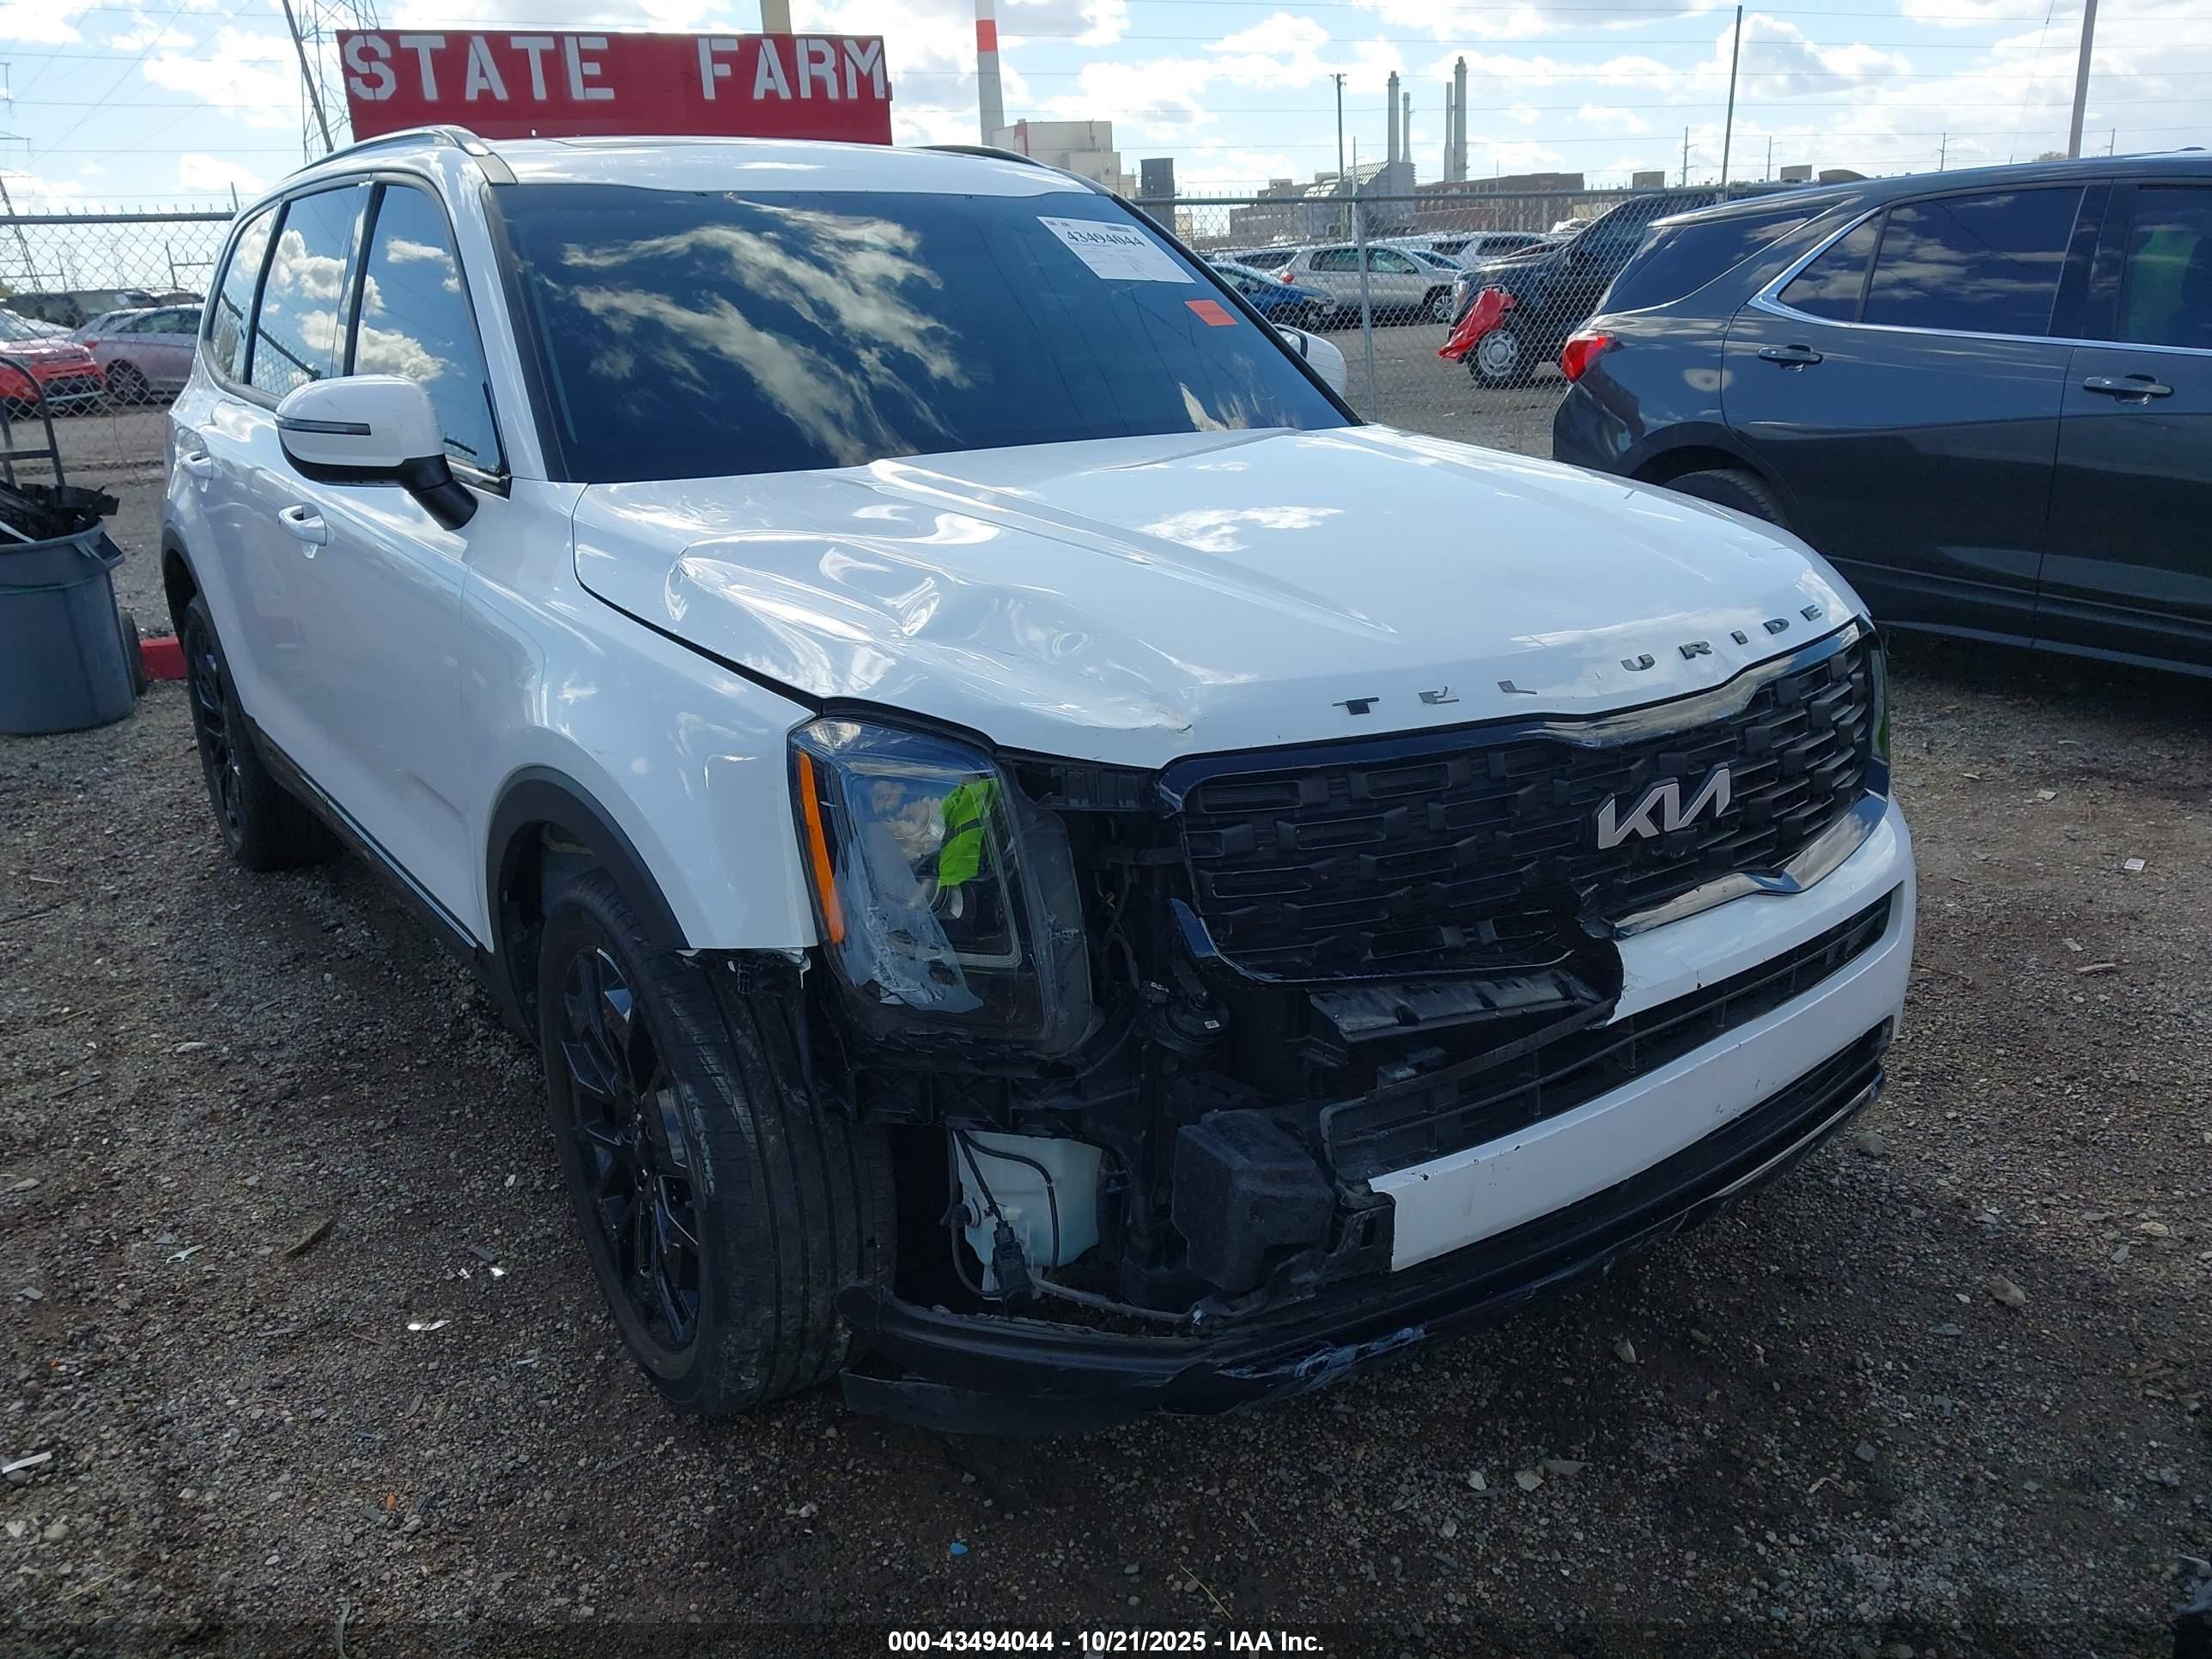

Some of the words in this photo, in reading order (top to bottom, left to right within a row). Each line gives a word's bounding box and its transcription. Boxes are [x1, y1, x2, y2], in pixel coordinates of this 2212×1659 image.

[344, 35, 615, 100] STATE
[697, 38, 885, 100] FARM
[1067, 231, 1146, 246] 43494044
[1597, 768, 1730, 849] KIA
